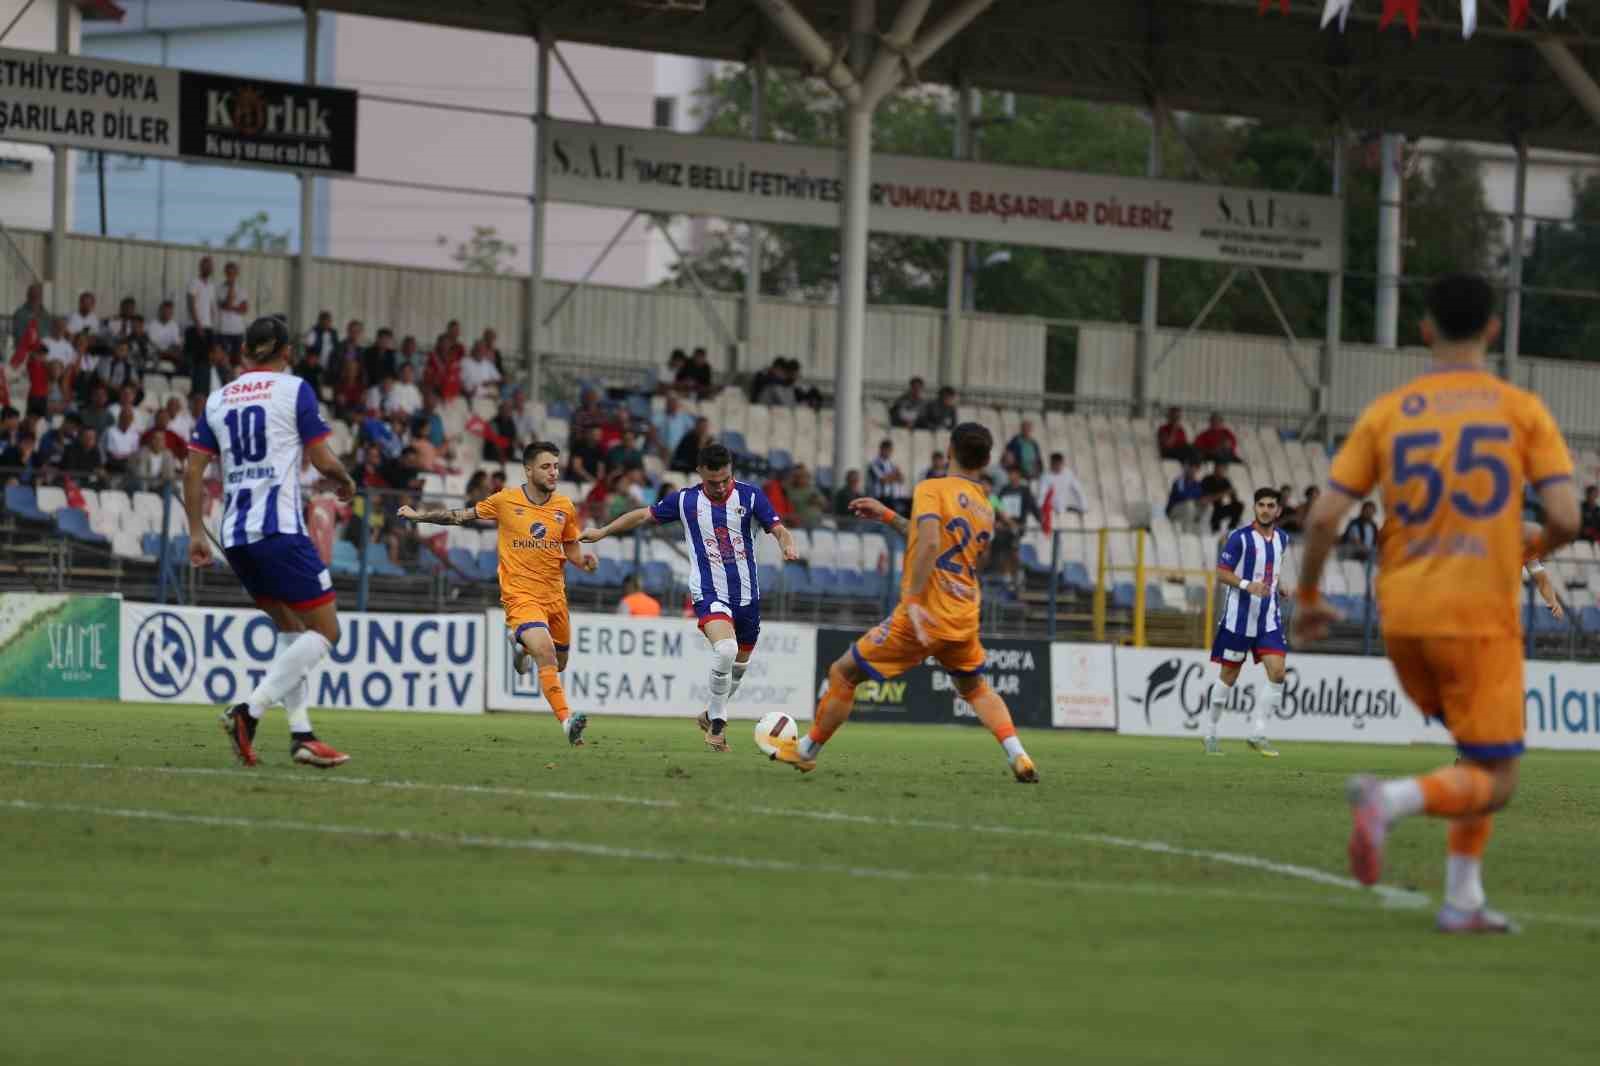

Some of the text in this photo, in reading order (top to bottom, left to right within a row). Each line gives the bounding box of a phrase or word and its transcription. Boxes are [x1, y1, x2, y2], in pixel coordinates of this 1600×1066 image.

[103, 107, 170, 145] DİLER
[688, 162, 746, 193] BELLİ
[968, 189, 1088, 226] BAŞARILAR
[1094, 200, 1174, 231] DİLERİZ
[223, 381, 276, 397] ESNAF
[224, 405, 267, 466] 10
[1393, 424, 1511, 526] 55
[204, 614, 476, 666] KOUNCU
[577, 627, 684, 657] ERDEM
[204, 666, 474, 707] OTMOTiV
